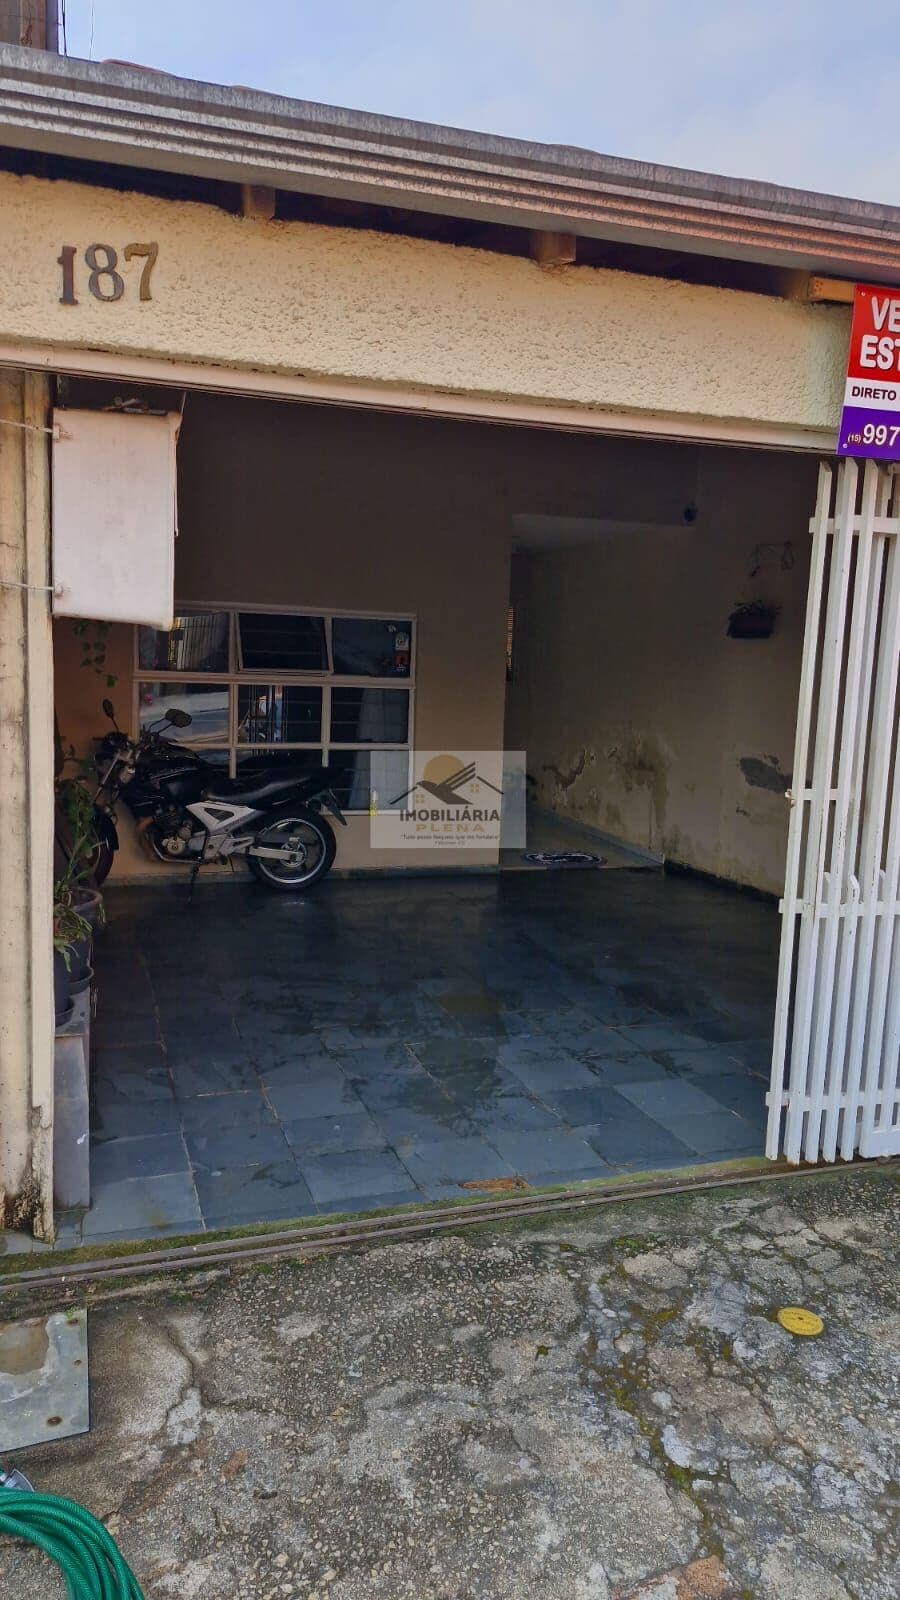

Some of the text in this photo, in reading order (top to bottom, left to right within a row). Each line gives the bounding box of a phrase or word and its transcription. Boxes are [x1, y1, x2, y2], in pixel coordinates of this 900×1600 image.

[57, 241, 159, 306] 187
[852, 386, 897, 401] DIRETO
[847, 423, 900, 447] (15) 997
